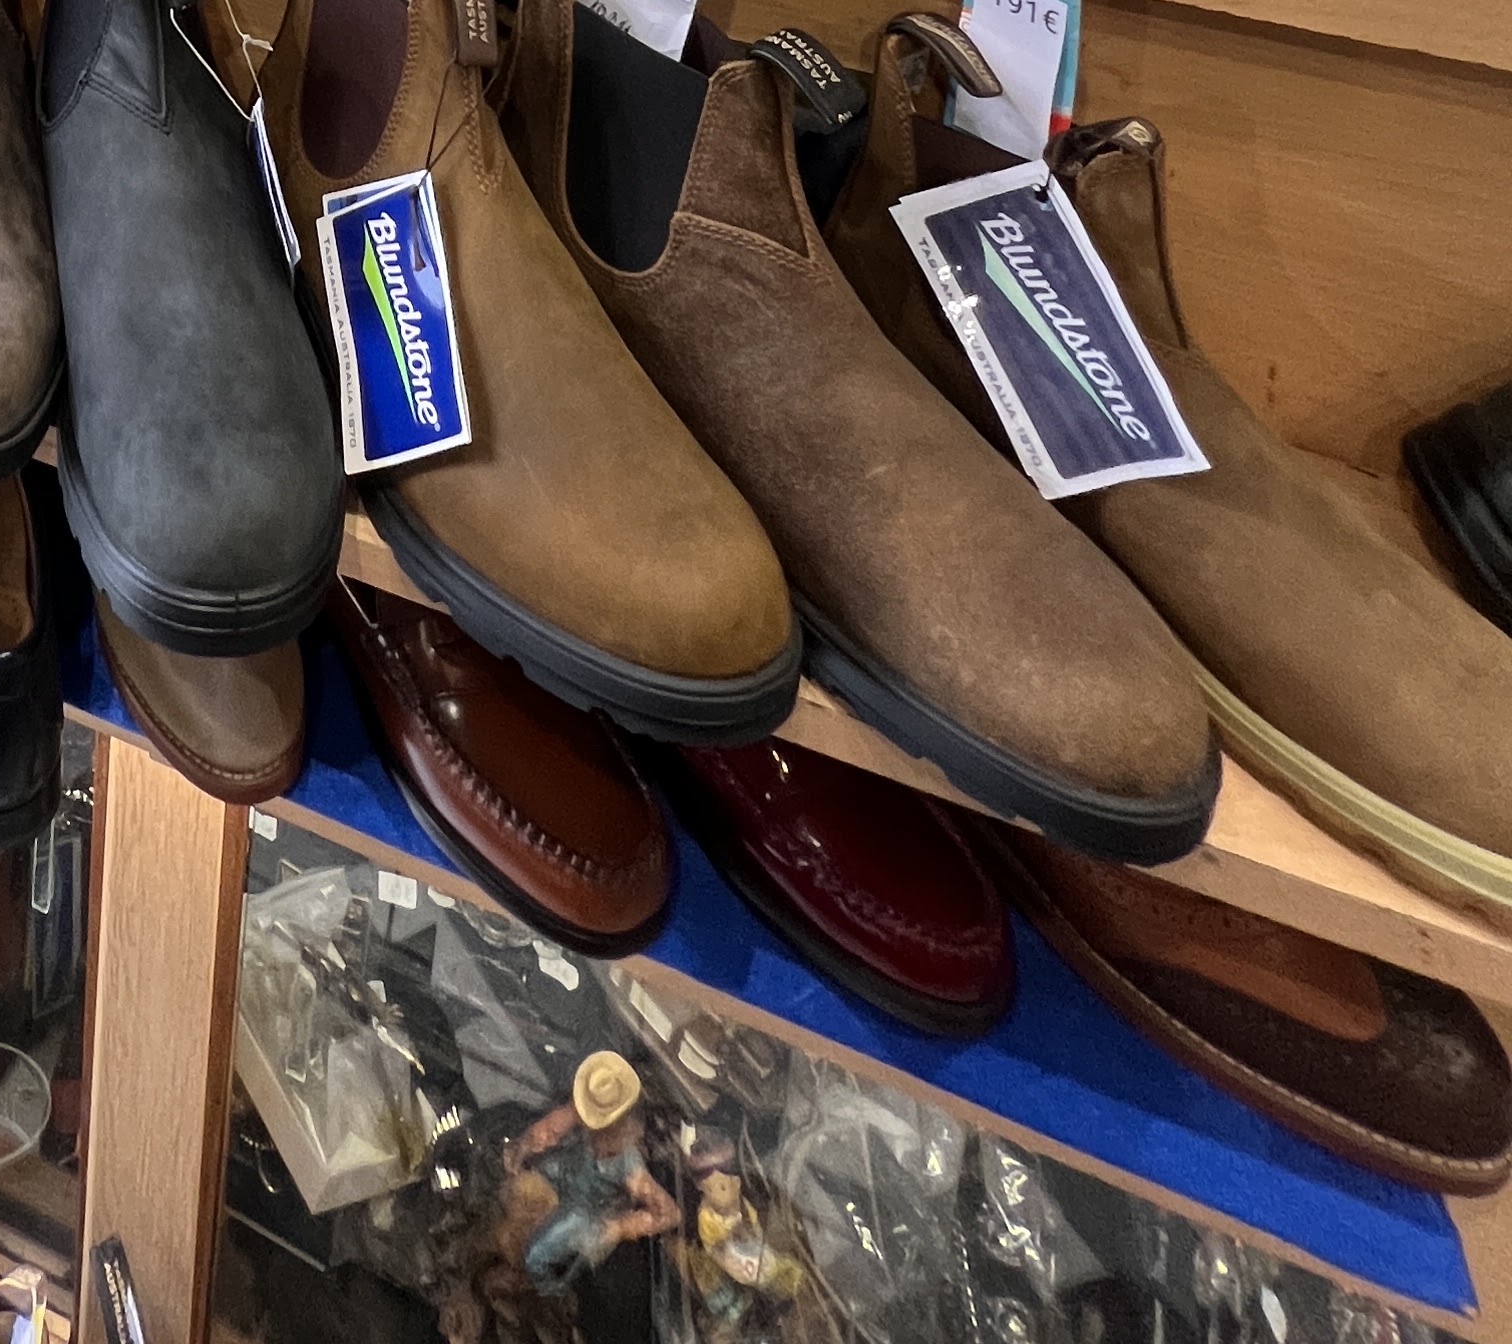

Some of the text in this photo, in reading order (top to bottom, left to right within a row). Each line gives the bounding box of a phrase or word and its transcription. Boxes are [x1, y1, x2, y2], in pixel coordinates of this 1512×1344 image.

[322, 234, 358, 450] TASMANIA AUSTRALIA 1870
[365, 210, 439, 427] Blundstone
[980, 212, 1152, 442] Blundstone
